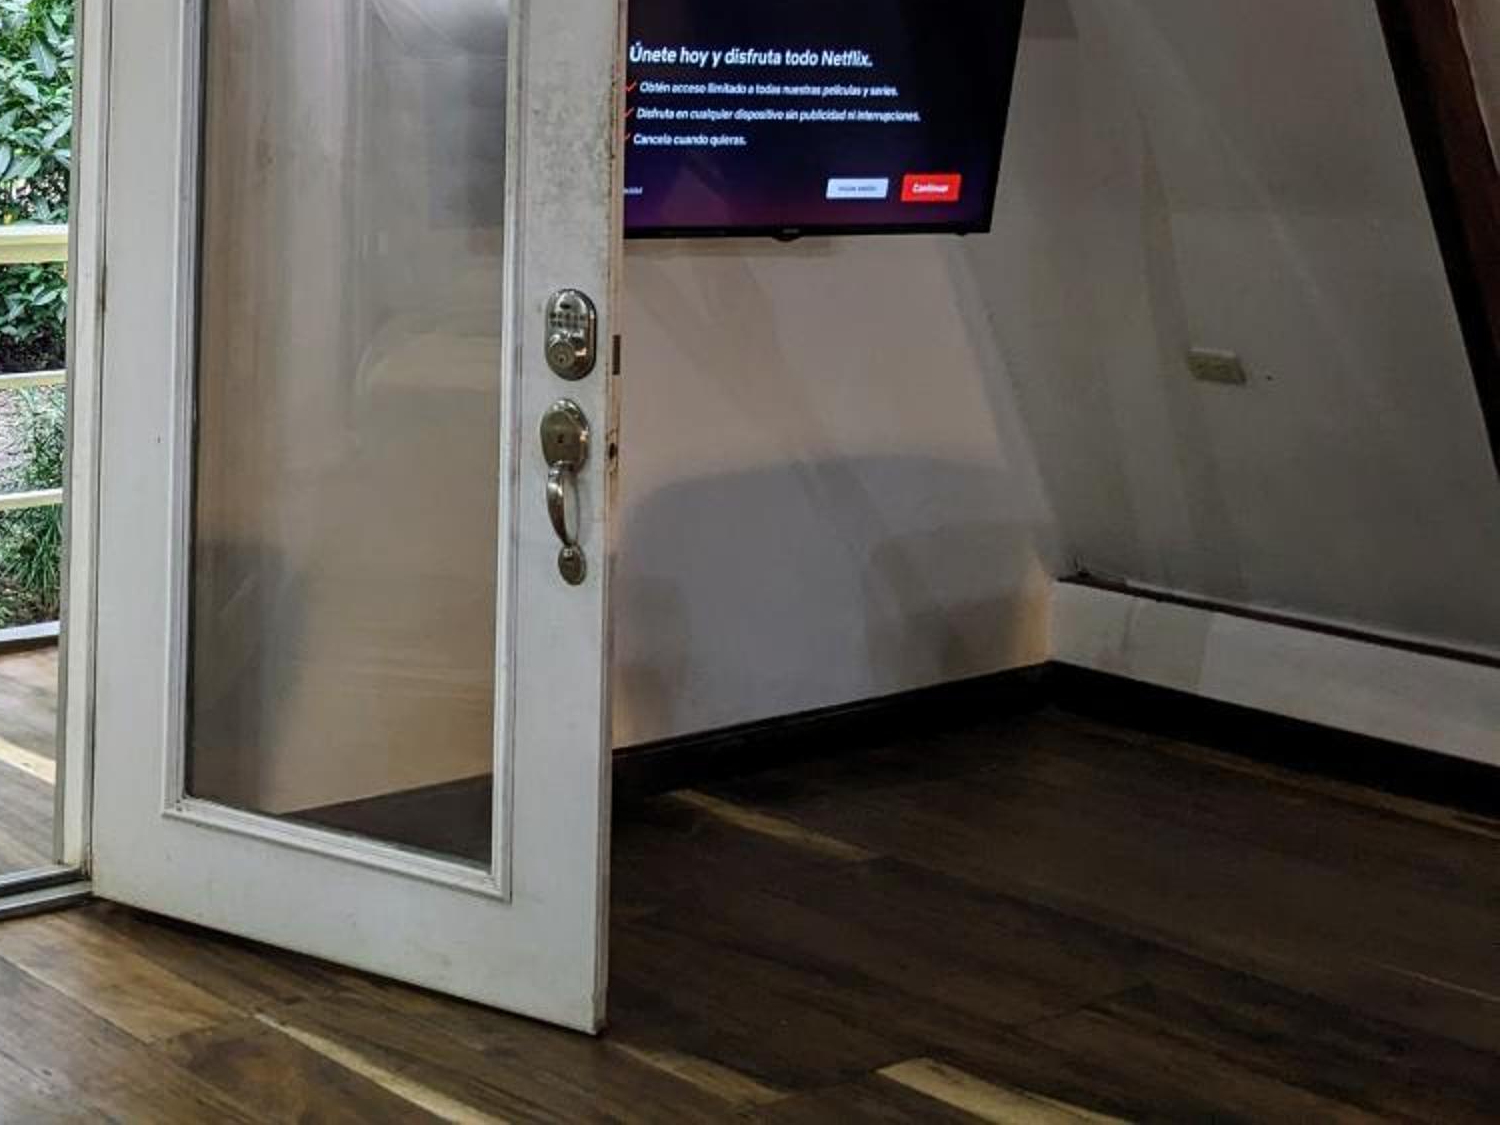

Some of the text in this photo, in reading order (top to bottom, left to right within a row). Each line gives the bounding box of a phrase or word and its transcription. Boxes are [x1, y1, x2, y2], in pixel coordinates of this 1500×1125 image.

[629, 41, 874, 68] Únete hoy y disfruta todo Netflix.
[639, 81, 671, 94] Obtén
[672, 84, 706, 94] acceso
[755, 84, 781, 95] todas
[782, 85, 820, 95] nuestras
[636, 107, 675, 120] Disfruta
[676, 110, 688, 119] en
[689, 108, 733, 121] cualquier
[734, 109, 784, 122] dispositivo
[785, 110, 799, 121] sin
[799, 109, 847, 123] publicidad
[633, 133, 747, 147] Cancela cuando quieras.
